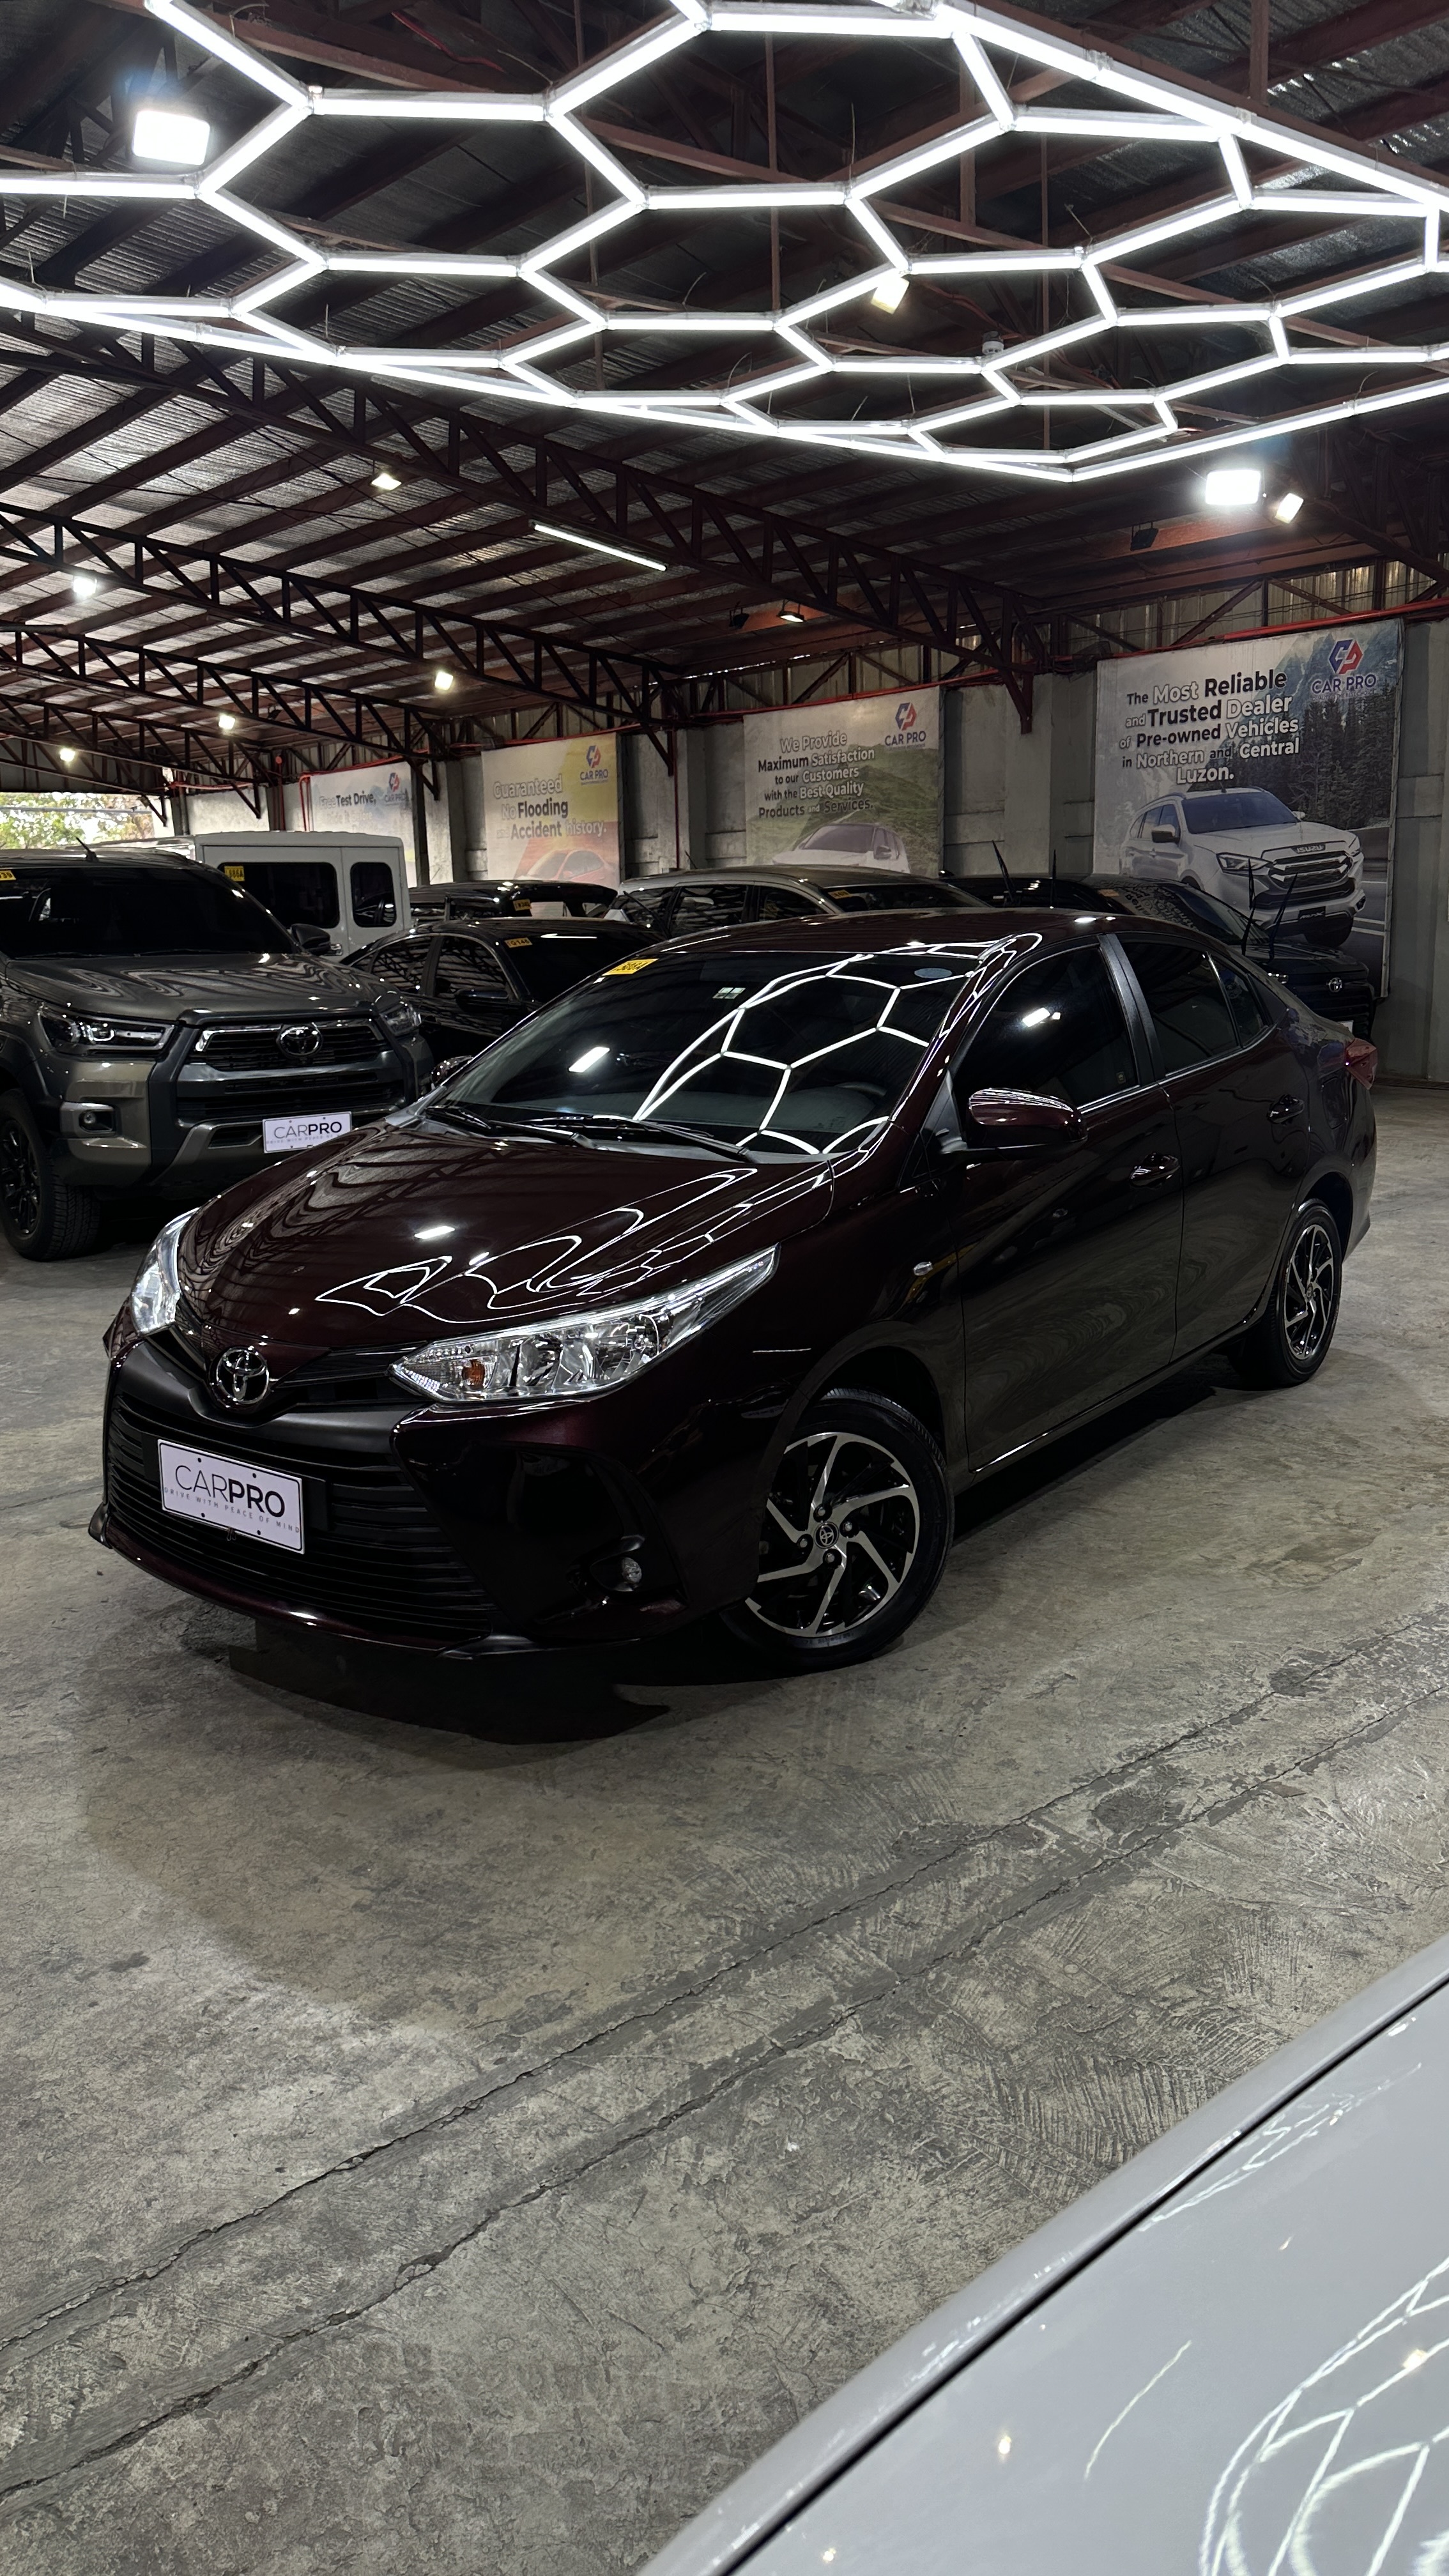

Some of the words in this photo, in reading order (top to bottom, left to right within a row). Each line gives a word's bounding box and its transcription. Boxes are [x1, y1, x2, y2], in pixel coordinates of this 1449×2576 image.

[1127, 693, 1149, 705] The
[1153, 681, 1199, 704] Most
[1204, 669, 1287, 697] Reliable
[1312, 678, 1342, 694] CAR
[1346, 673, 1377, 691] PRO
[1126, 714, 1146, 728] and
[1147, 700, 1222, 727] Trusted
[1226, 694, 1293, 719] Dealer
[780, 737, 800, 753] We
[802, 730, 848, 751] Provide
[884, 734, 904, 746] CAR
[906, 730, 926, 744] PRO
[1119, 737, 1131, 749] of
[1136, 723, 1221, 748] Pre-owned
[1225, 717, 1299, 739] Vehicles
[758, 756, 809, 772] Maximum
[811, 747, 875, 767] Satisfaction
[1122, 755, 1133, 768] in
[1136, 749, 1204, 769] Northern
[1209, 747, 1232, 760] and
[1239, 737, 1300, 759] Central
[493, 773, 564, 799] Guaranteed
[580, 770, 594, 781] CAR
[595, 769, 609, 780] PRO
[775, 774, 784, 785] to
[785, 775, 799, 784] our
[802, 766, 859, 783] Customers
[1176, 765, 1235, 785] Luzon.
[336, 794, 352, 807] Test
[353, 790, 376, 806] Drive,
[764, 788, 783, 801] with
[784, 786, 797, 799] the
[799, 786, 824, 799] Best
[825, 780, 864, 798] Quality
[502, 803, 517, 821] No
[518, 797, 569, 818] Flooding
[758, 804, 805, 818] Products
[808, 804, 820, 813] and
[824, 797, 873, 813] Services.
[510, 820, 562, 840] Accident
[565, 817, 607, 838] history.
[1296, 845, 1322, 853] ISUZU
[273, 1121, 342, 1139] CARPRO
[175, 1465, 286, 1518] CARPRO
[164, 1487, 190, 1500] DRIVE
[195, 1497, 218, 1508] WITH
[224, 1505, 253, 1519] PEACE
[276, 1521, 300, 1533] MIND
